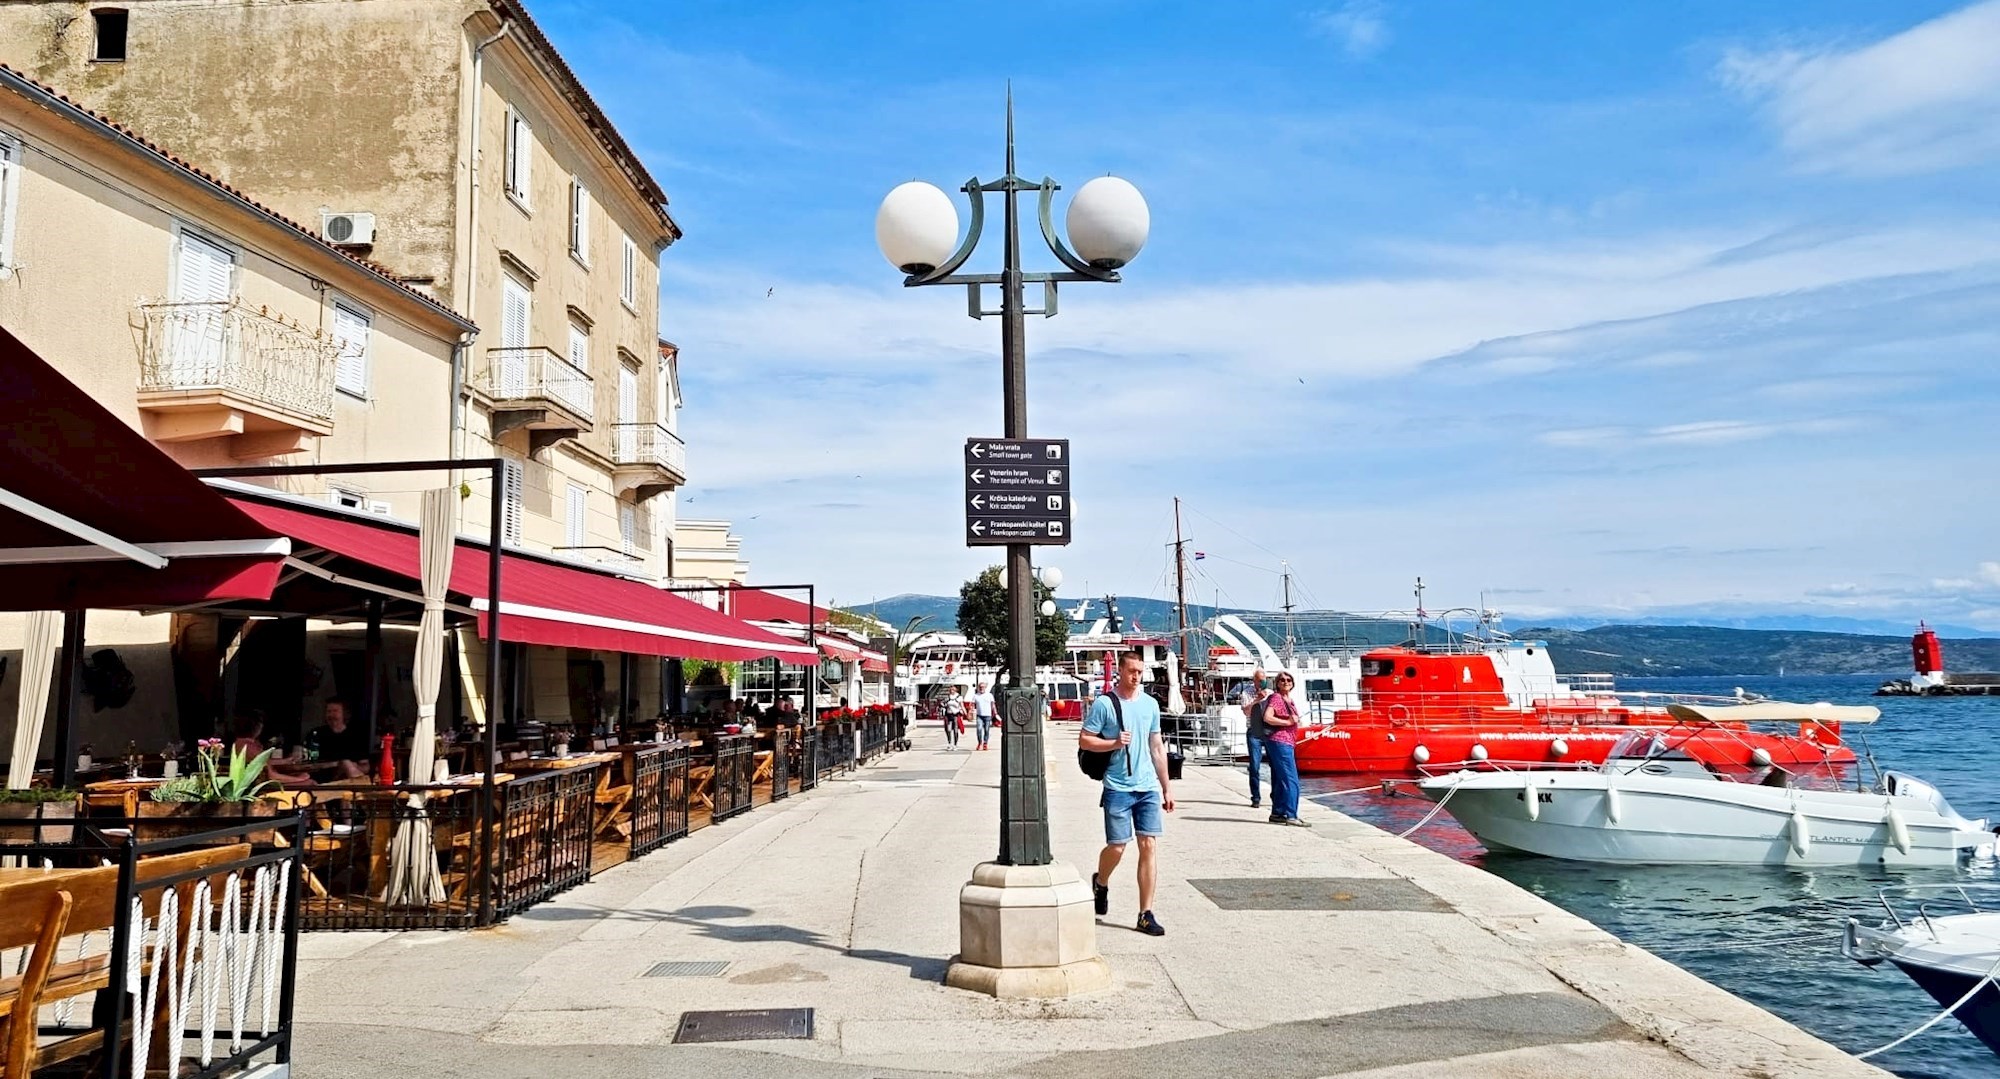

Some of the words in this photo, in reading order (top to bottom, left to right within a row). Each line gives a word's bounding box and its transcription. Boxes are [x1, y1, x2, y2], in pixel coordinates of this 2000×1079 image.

[1020, 452, 1033, 460] gate
[1001, 477, 1020, 485] temple
[990, 521, 1029, 529] Frankopanski
[990, 529, 1019, 537] Frankopan
[1305, 730, 1320, 740] Big
[1321, 730, 1352, 739] Marlin
[1810, 835, 1852, 843] TLANTIC
